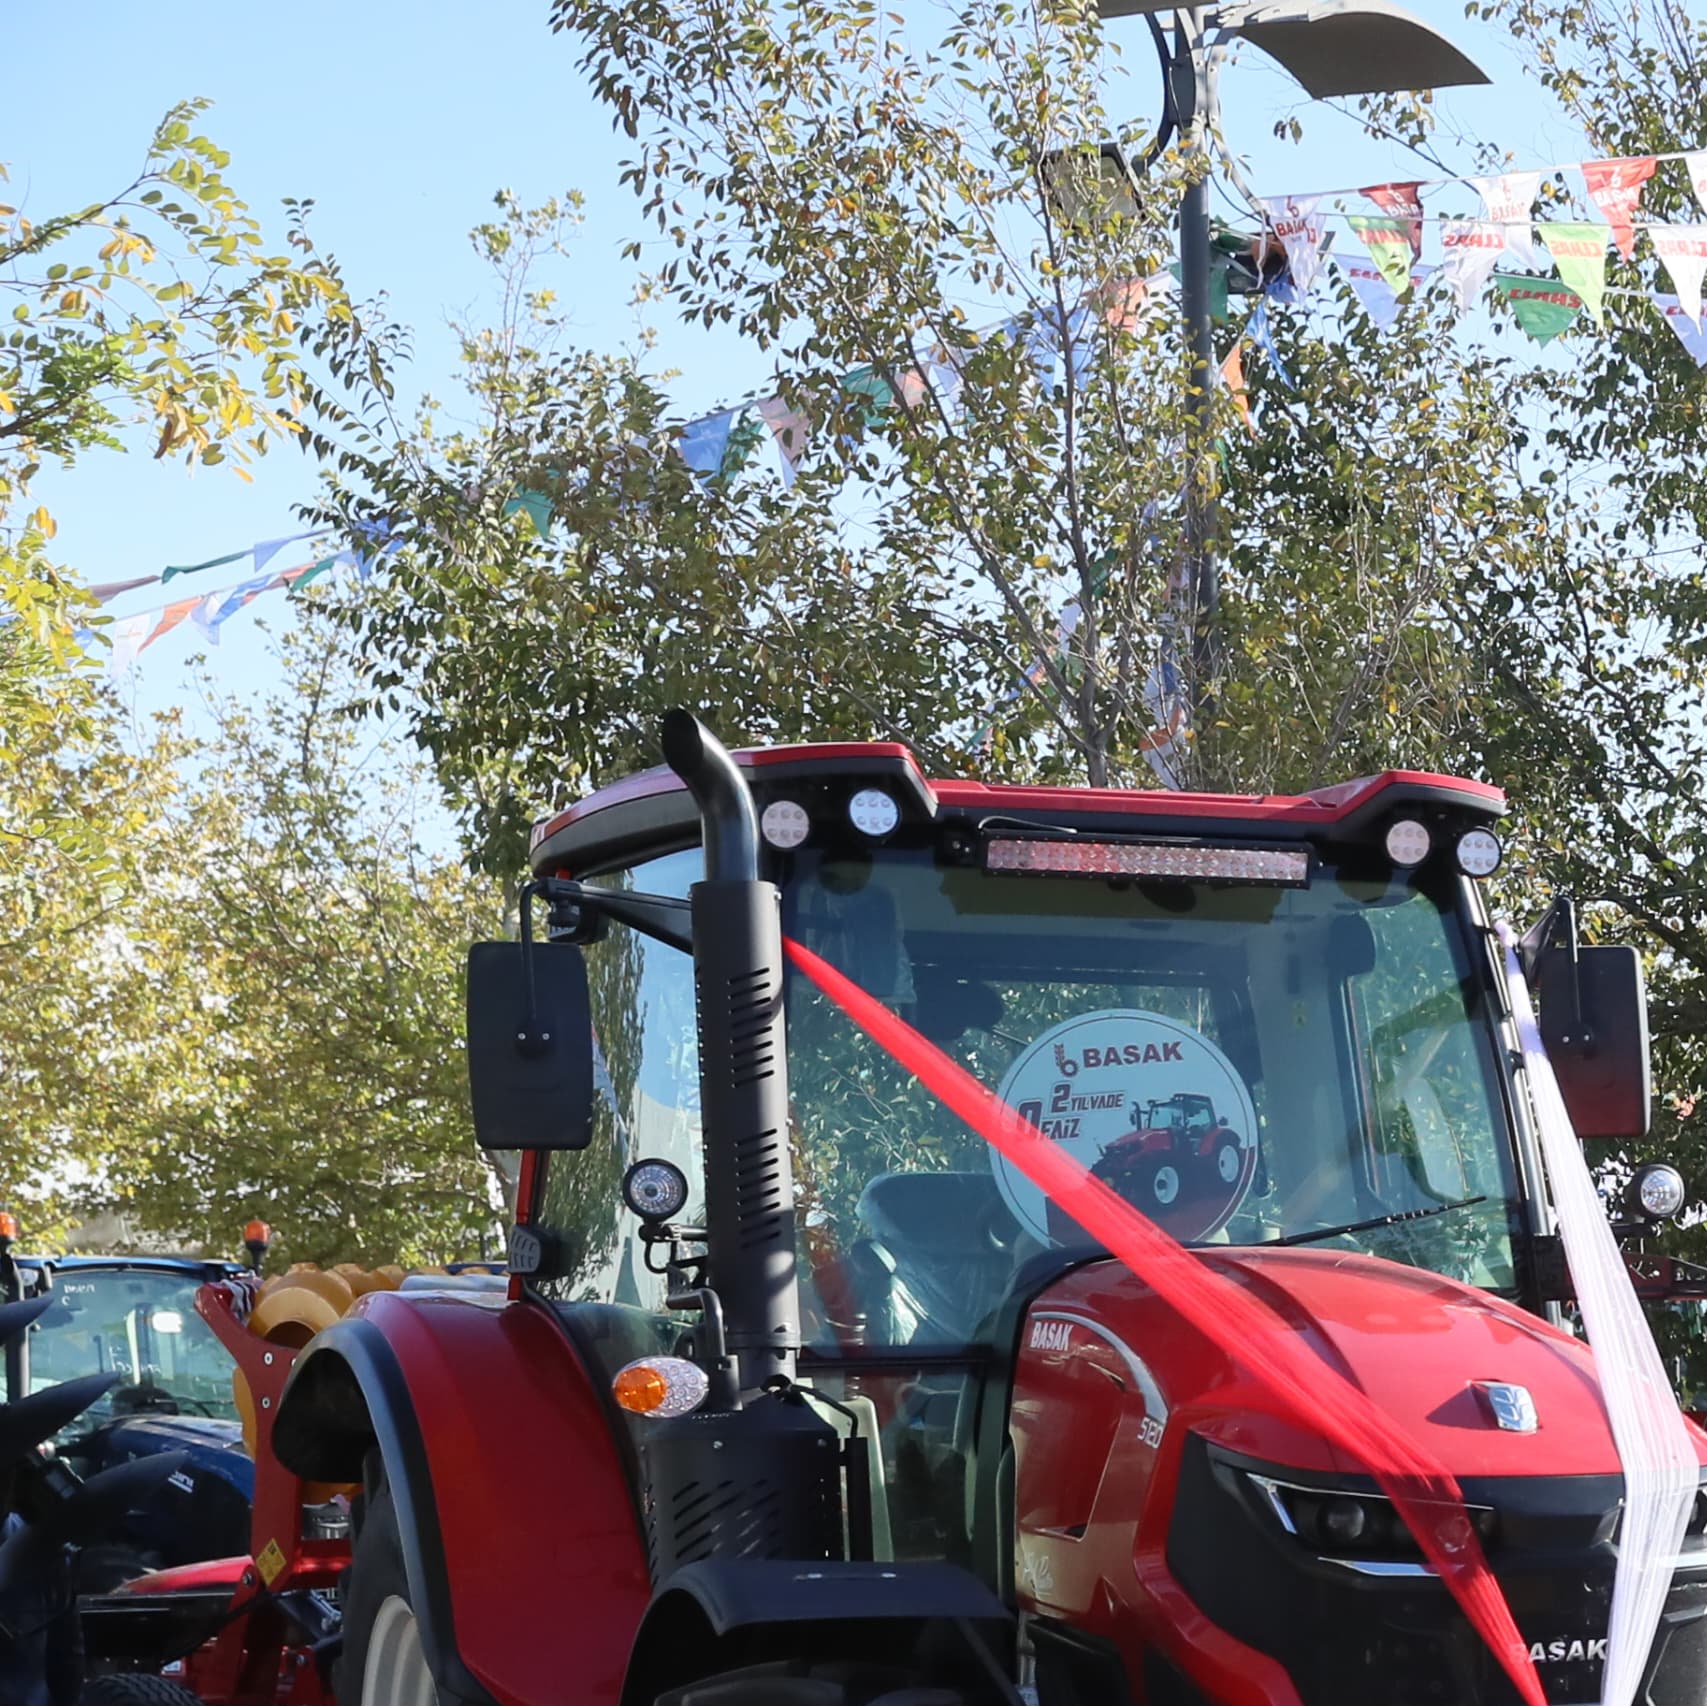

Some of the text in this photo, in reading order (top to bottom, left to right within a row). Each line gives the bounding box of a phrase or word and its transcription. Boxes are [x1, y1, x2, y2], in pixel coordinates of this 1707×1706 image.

[1082, 1041, 1183, 1069] BASAK
[1051, 1083, 1071, 1113] 2
[1030, 1321, 1075, 1351] BASAK
[1509, 1639, 1609, 1663] ASAK
